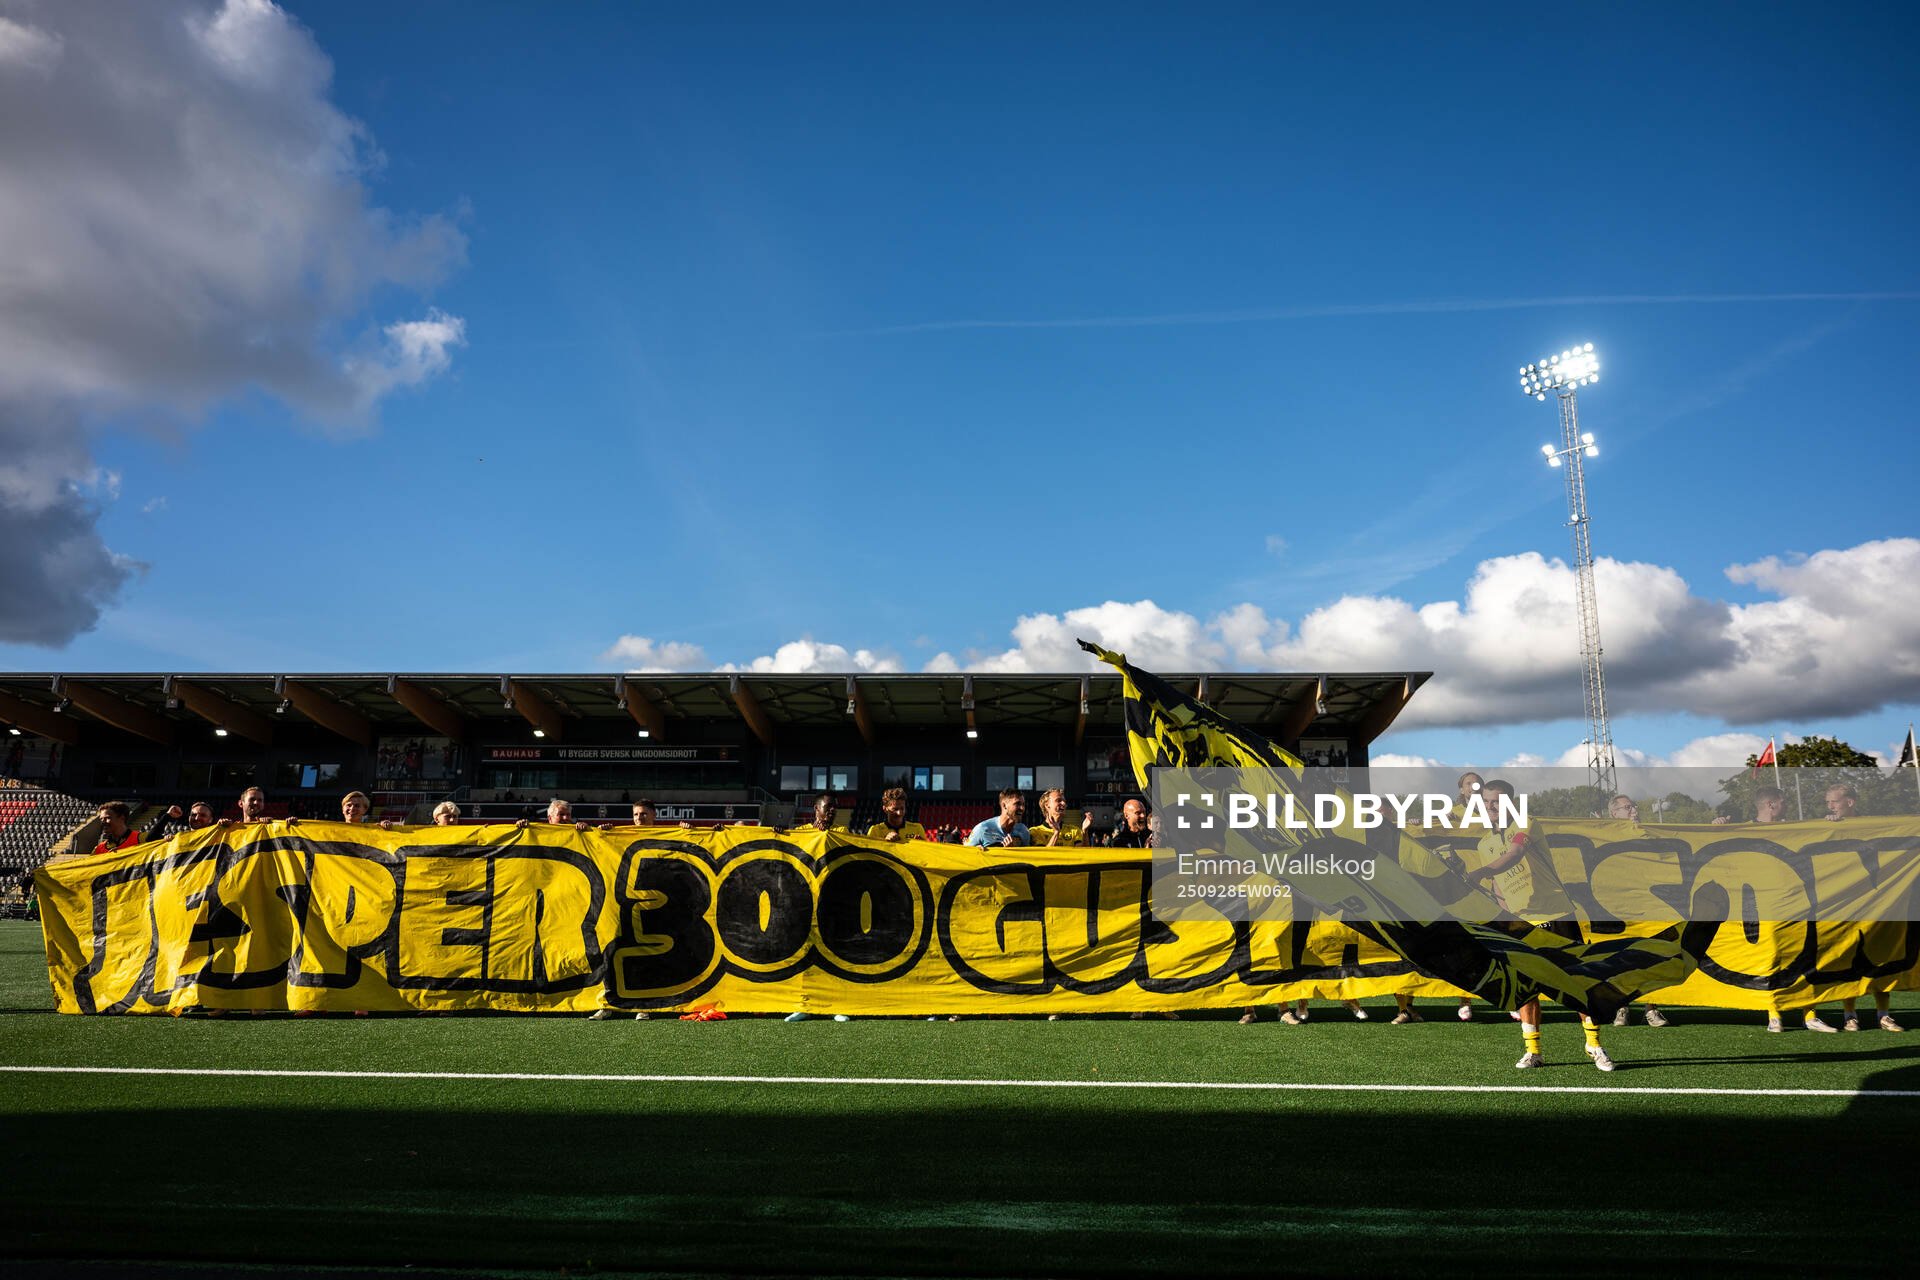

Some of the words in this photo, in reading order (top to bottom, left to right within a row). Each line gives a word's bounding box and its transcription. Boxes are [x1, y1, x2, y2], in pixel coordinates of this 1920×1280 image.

[492, 749, 541, 758] BAUHAUS
[558, 749, 566, 758] VI
[568, 749, 598, 758] BYGGER
[600, 749, 630, 758] SVENSK
[632, 749, 698, 758] UNGDOMSIDROTT
[656, 805, 695, 819] dium
[73, 836, 606, 1015] JESPER
[603, 839, 933, 1010] 300
